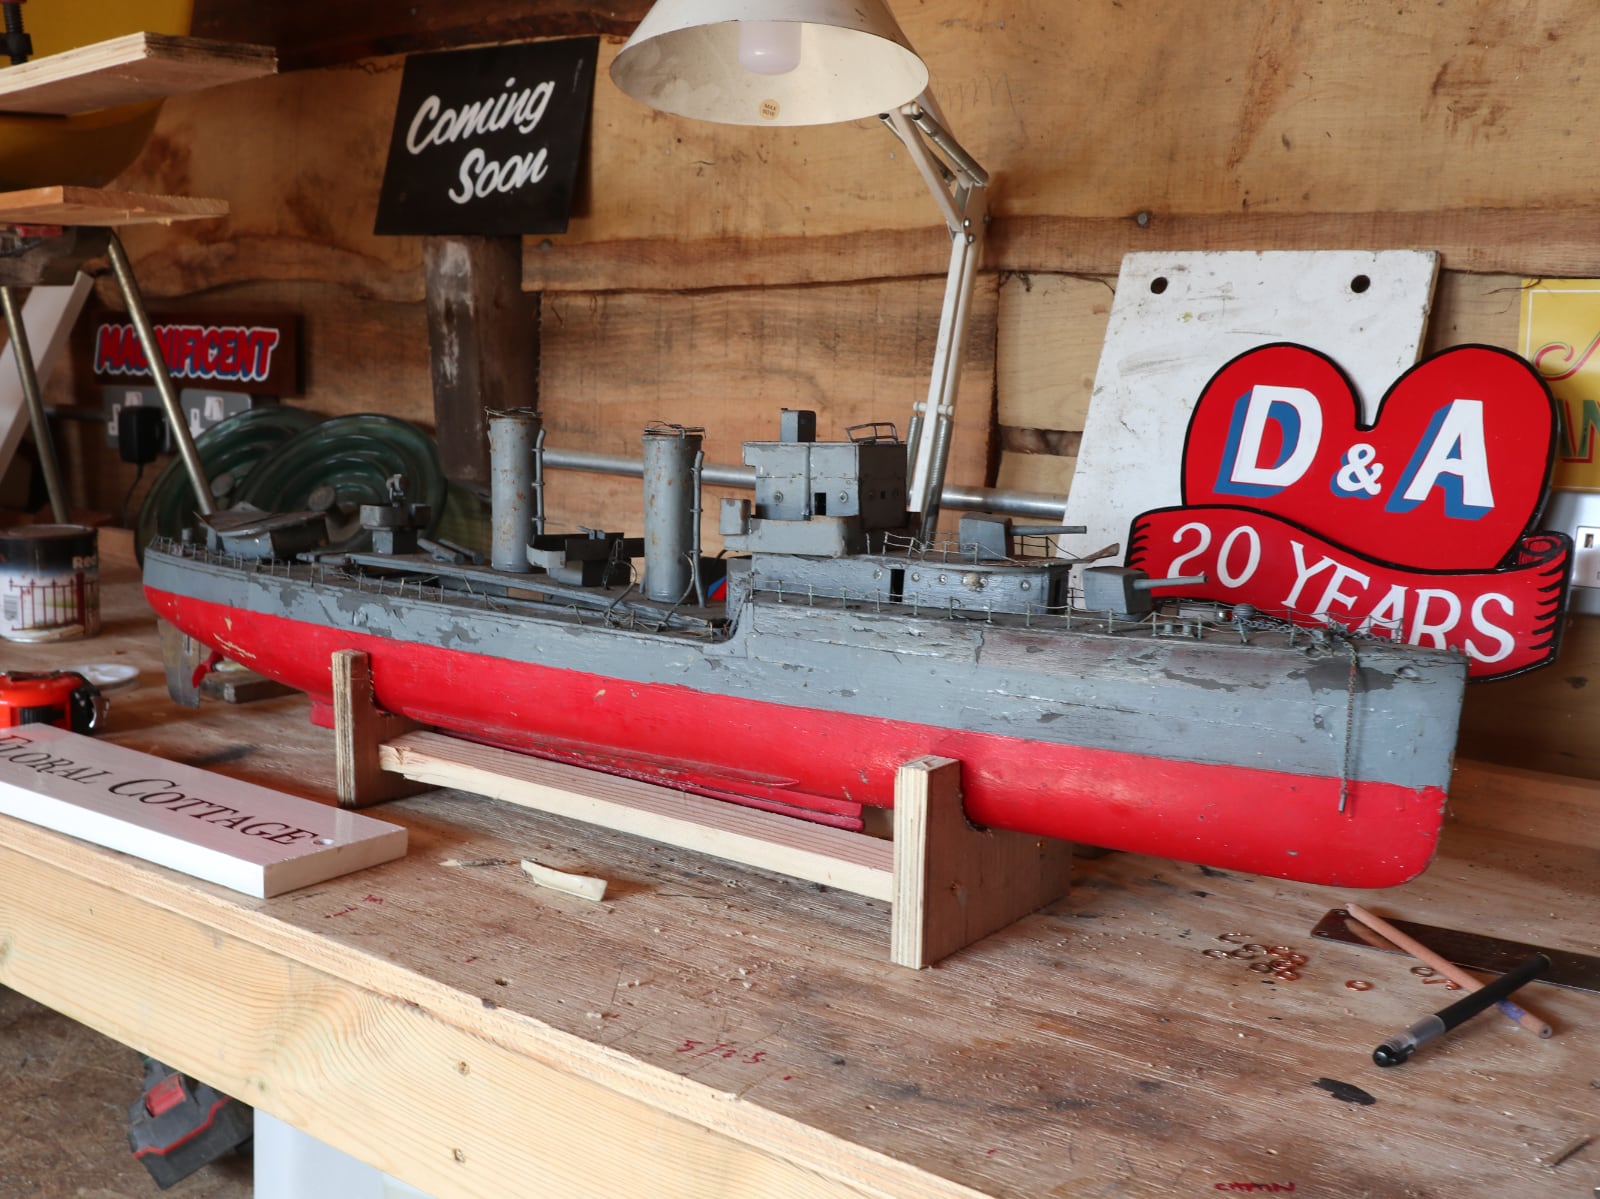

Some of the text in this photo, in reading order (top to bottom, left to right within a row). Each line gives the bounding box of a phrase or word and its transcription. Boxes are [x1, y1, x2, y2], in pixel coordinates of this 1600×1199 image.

[406, 77, 555, 155] Coming
[448, 147, 548, 204] Soon
[1213, 384, 1323, 498] D
[1330, 443, 1384, 499] &
[1384, 399, 1495, 520] A
[1166, 521, 1515, 664] 20 YEARS
[108, 778, 319, 845] COTTAGE
